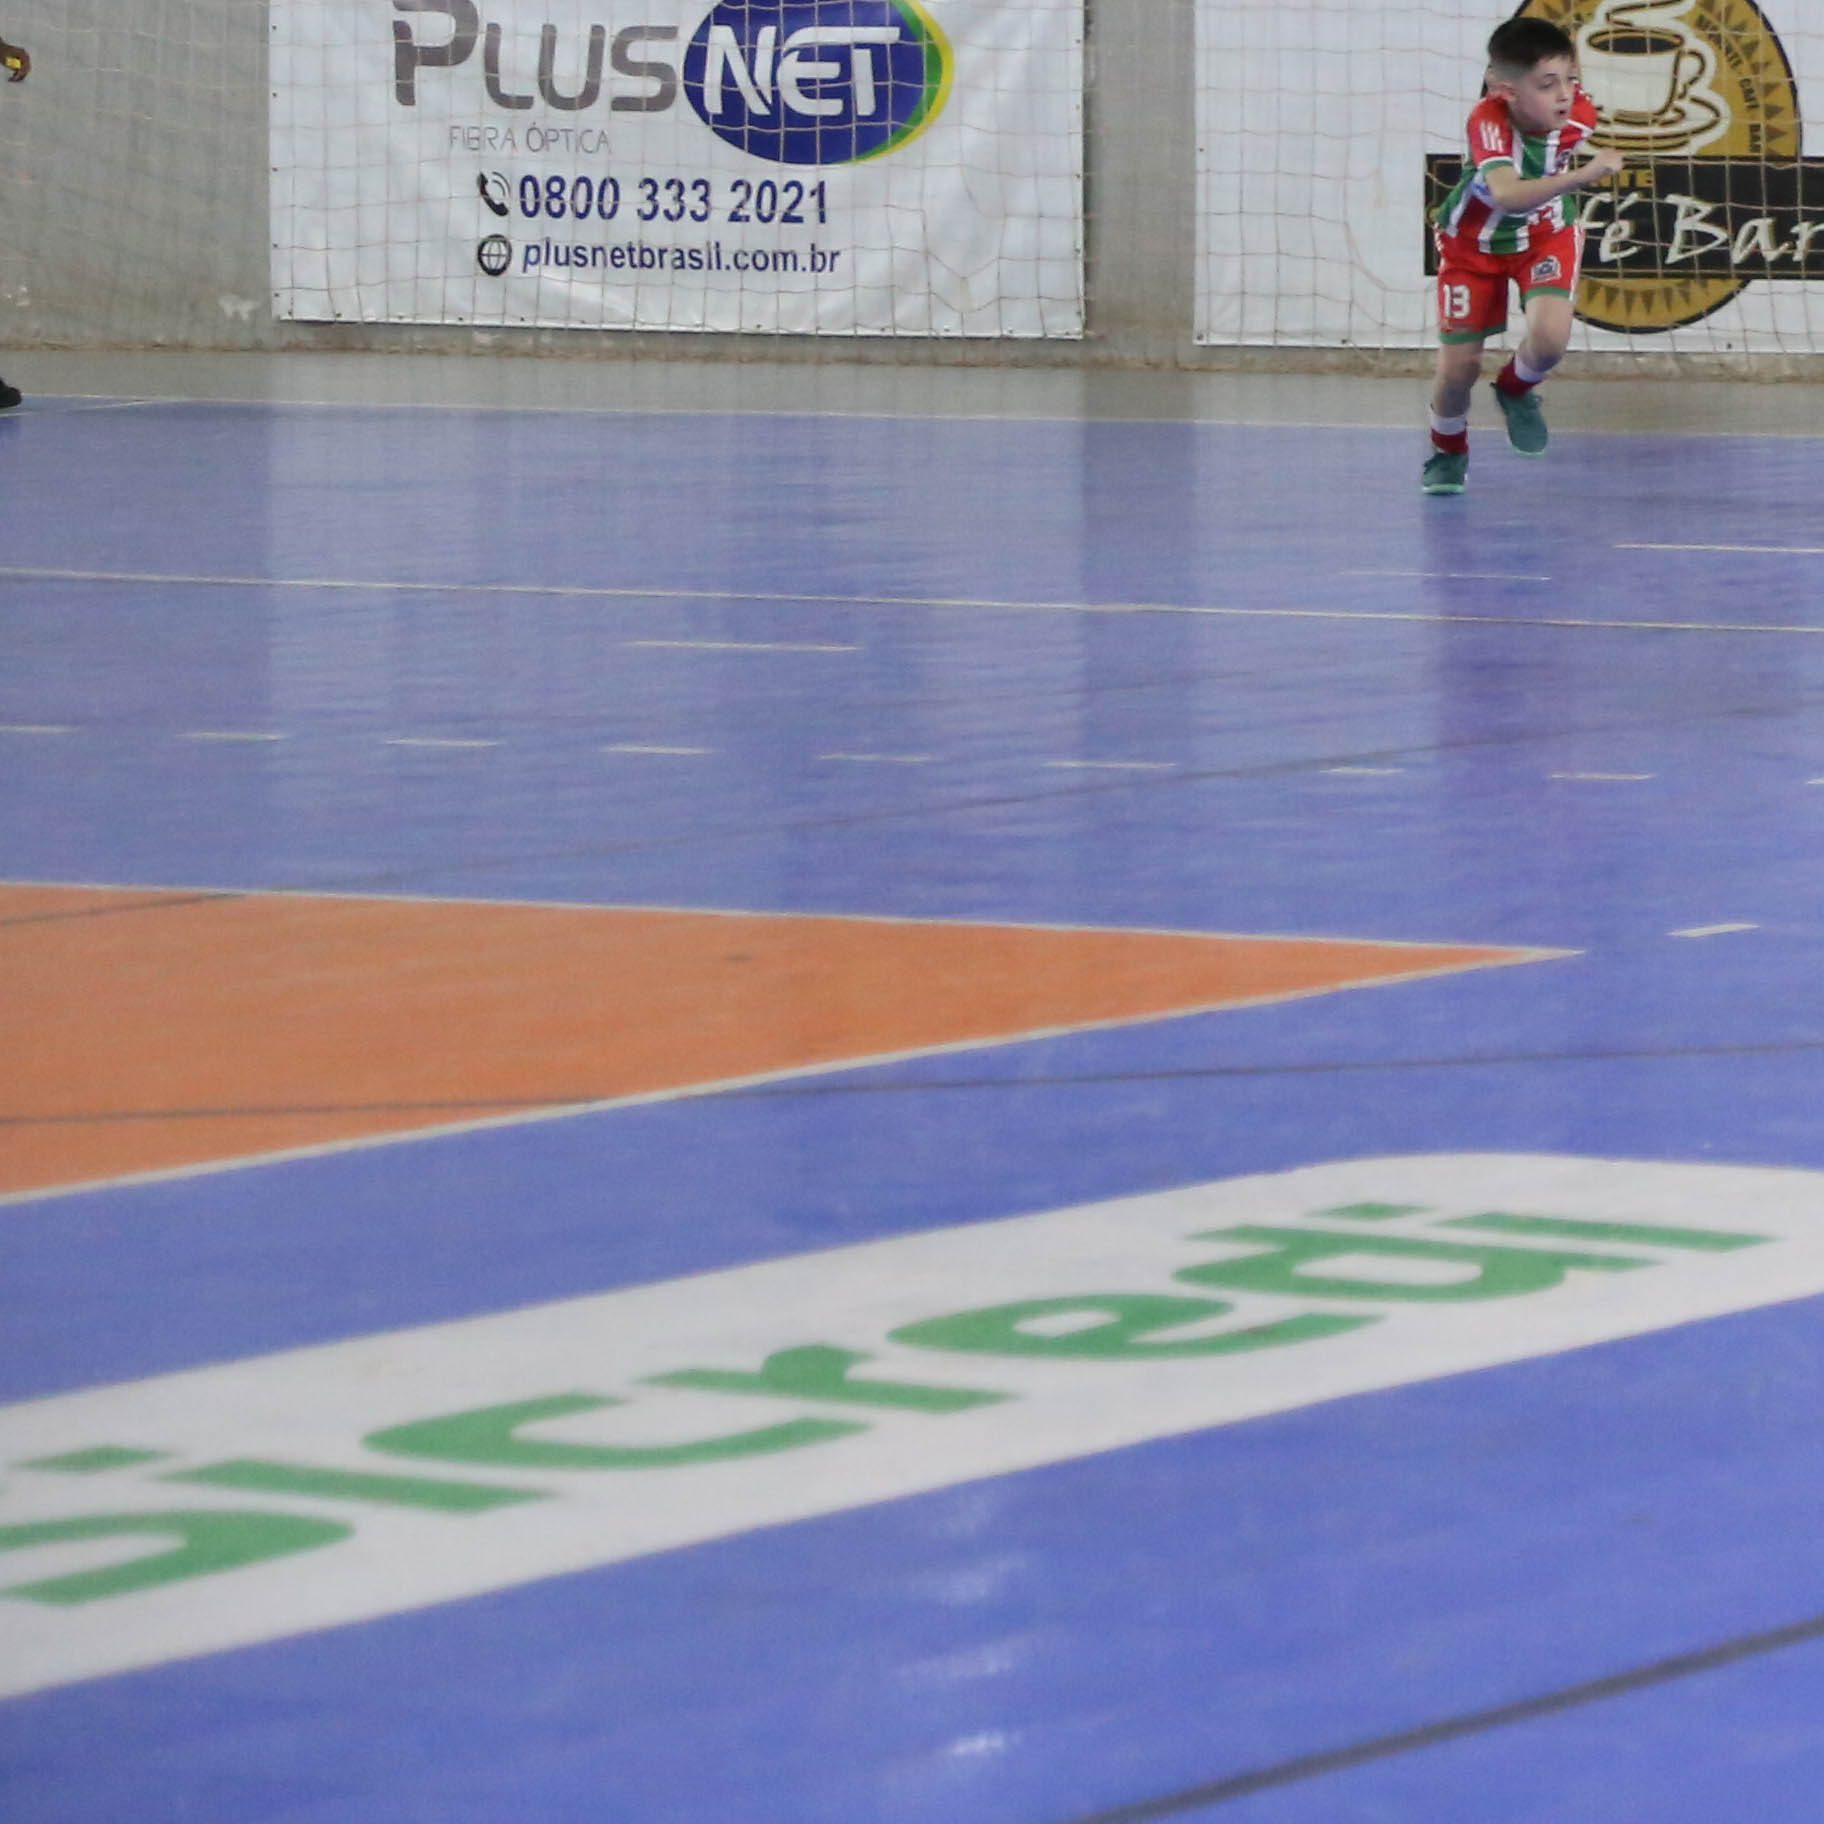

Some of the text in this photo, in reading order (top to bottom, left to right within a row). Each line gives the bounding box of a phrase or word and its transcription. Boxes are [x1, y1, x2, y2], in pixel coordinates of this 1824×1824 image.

[449, 122, 611, 154] FIBRA ÓPTICA
[519, 174, 827, 224] 0800 333 2021
[1580, 192, 1643, 263] fé
[522, 237, 841, 273] plusnetbrasil.com.br
[1442, 283, 1472, 319] 13
